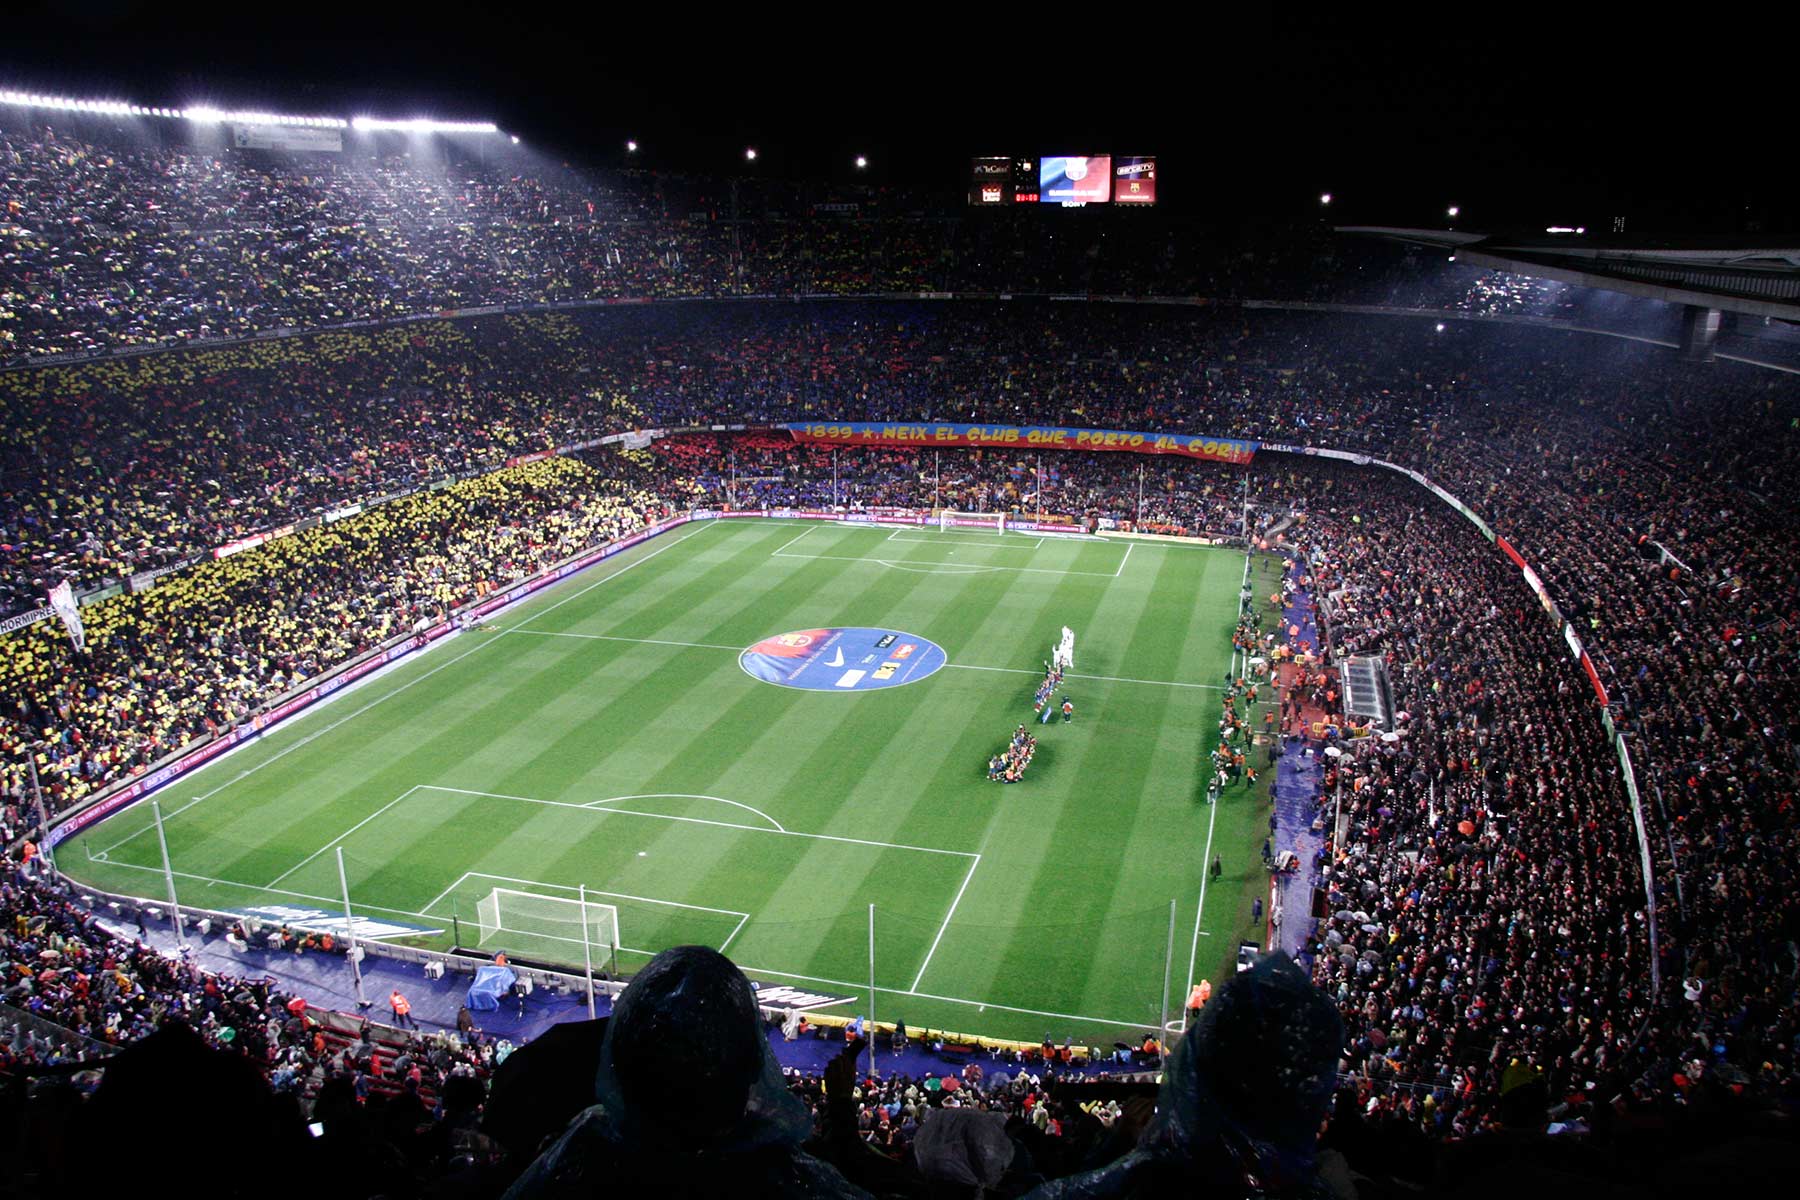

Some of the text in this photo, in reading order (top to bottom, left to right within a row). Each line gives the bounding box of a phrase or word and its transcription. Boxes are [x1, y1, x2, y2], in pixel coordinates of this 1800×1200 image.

[806, 424, 852, 438] 1899
[882, 426, 928, 440] NEIX
[935, 427, 959, 441] EL
[967, 428, 1020, 442] CLUB
[1027, 429, 1067, 444] QUE
[1076, 431, 1144, 446] PORTO
[1154, 436, 1178, 450] AL
[1262, 442, 1292, 452] LUBESA
